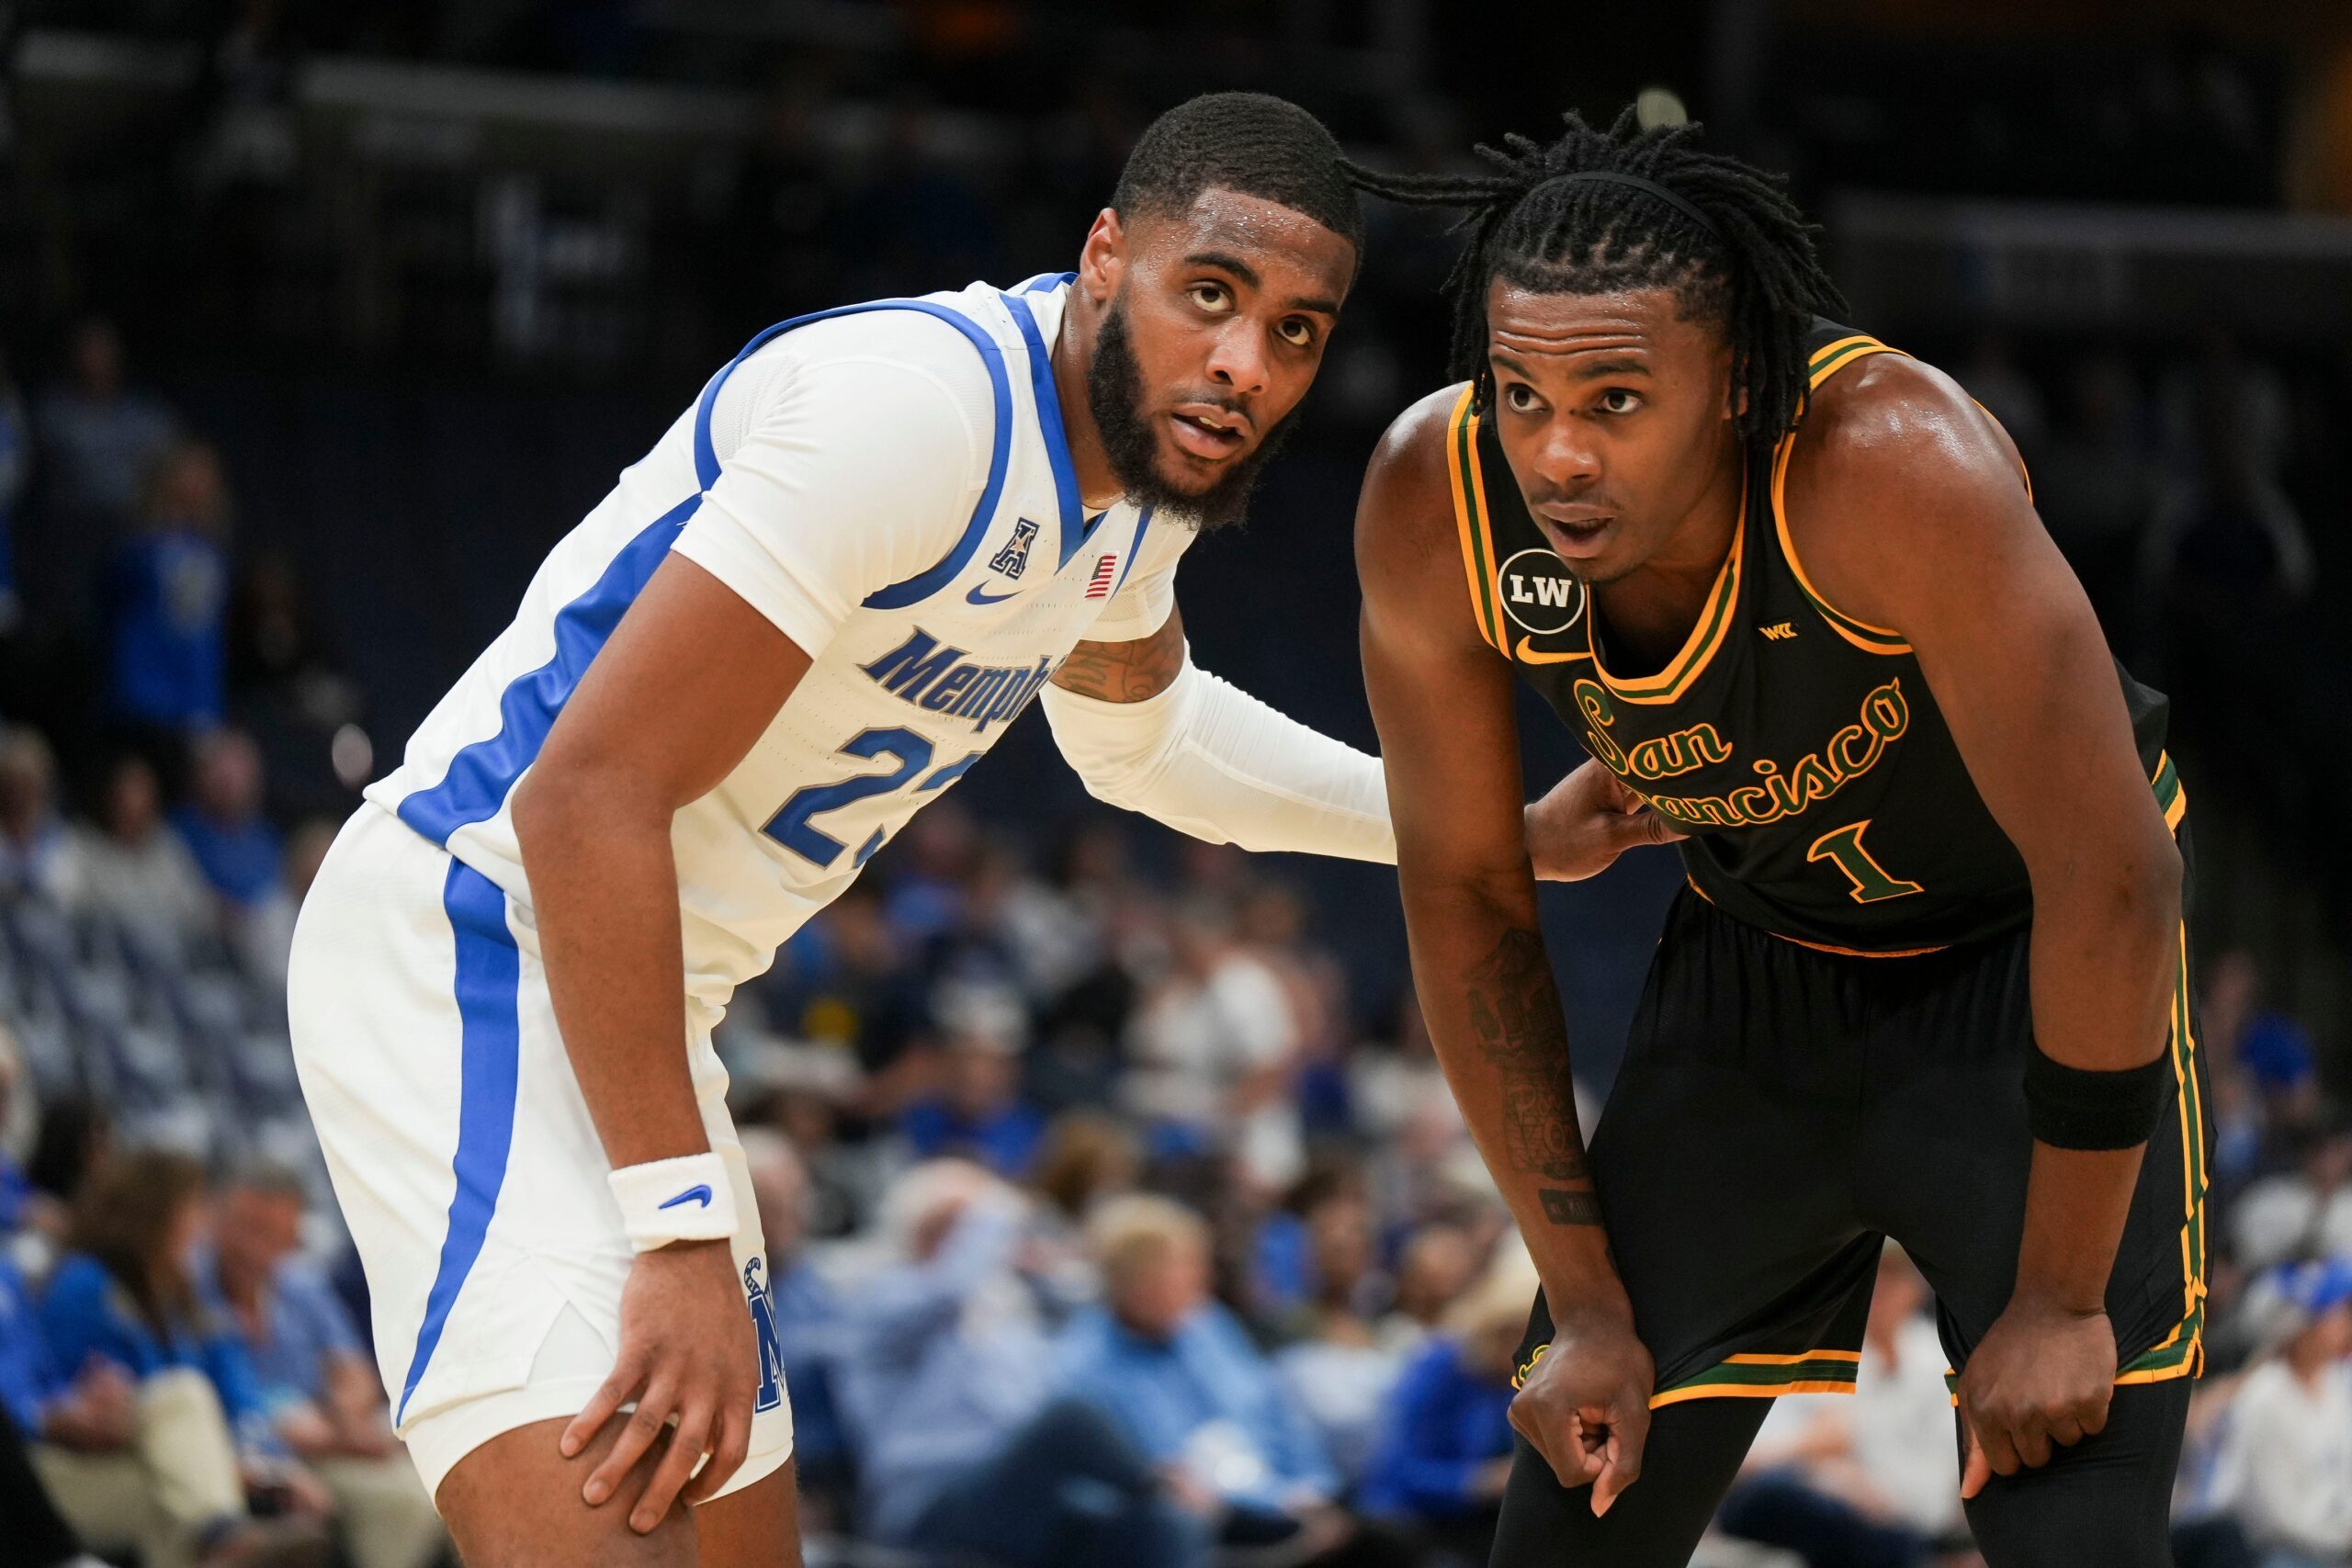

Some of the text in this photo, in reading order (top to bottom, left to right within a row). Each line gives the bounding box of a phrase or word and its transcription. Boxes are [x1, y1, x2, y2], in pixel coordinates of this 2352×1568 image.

[1510, 573, 1572, 608] LW
[1758, 622, 1798, 641] WCC
[854, 625, 1069, 734] Memph
[1573, 678, 1733, 781] San
[1638, 676, 1909, 826] ancisco
[1806, 818, 1925, 905] 1
